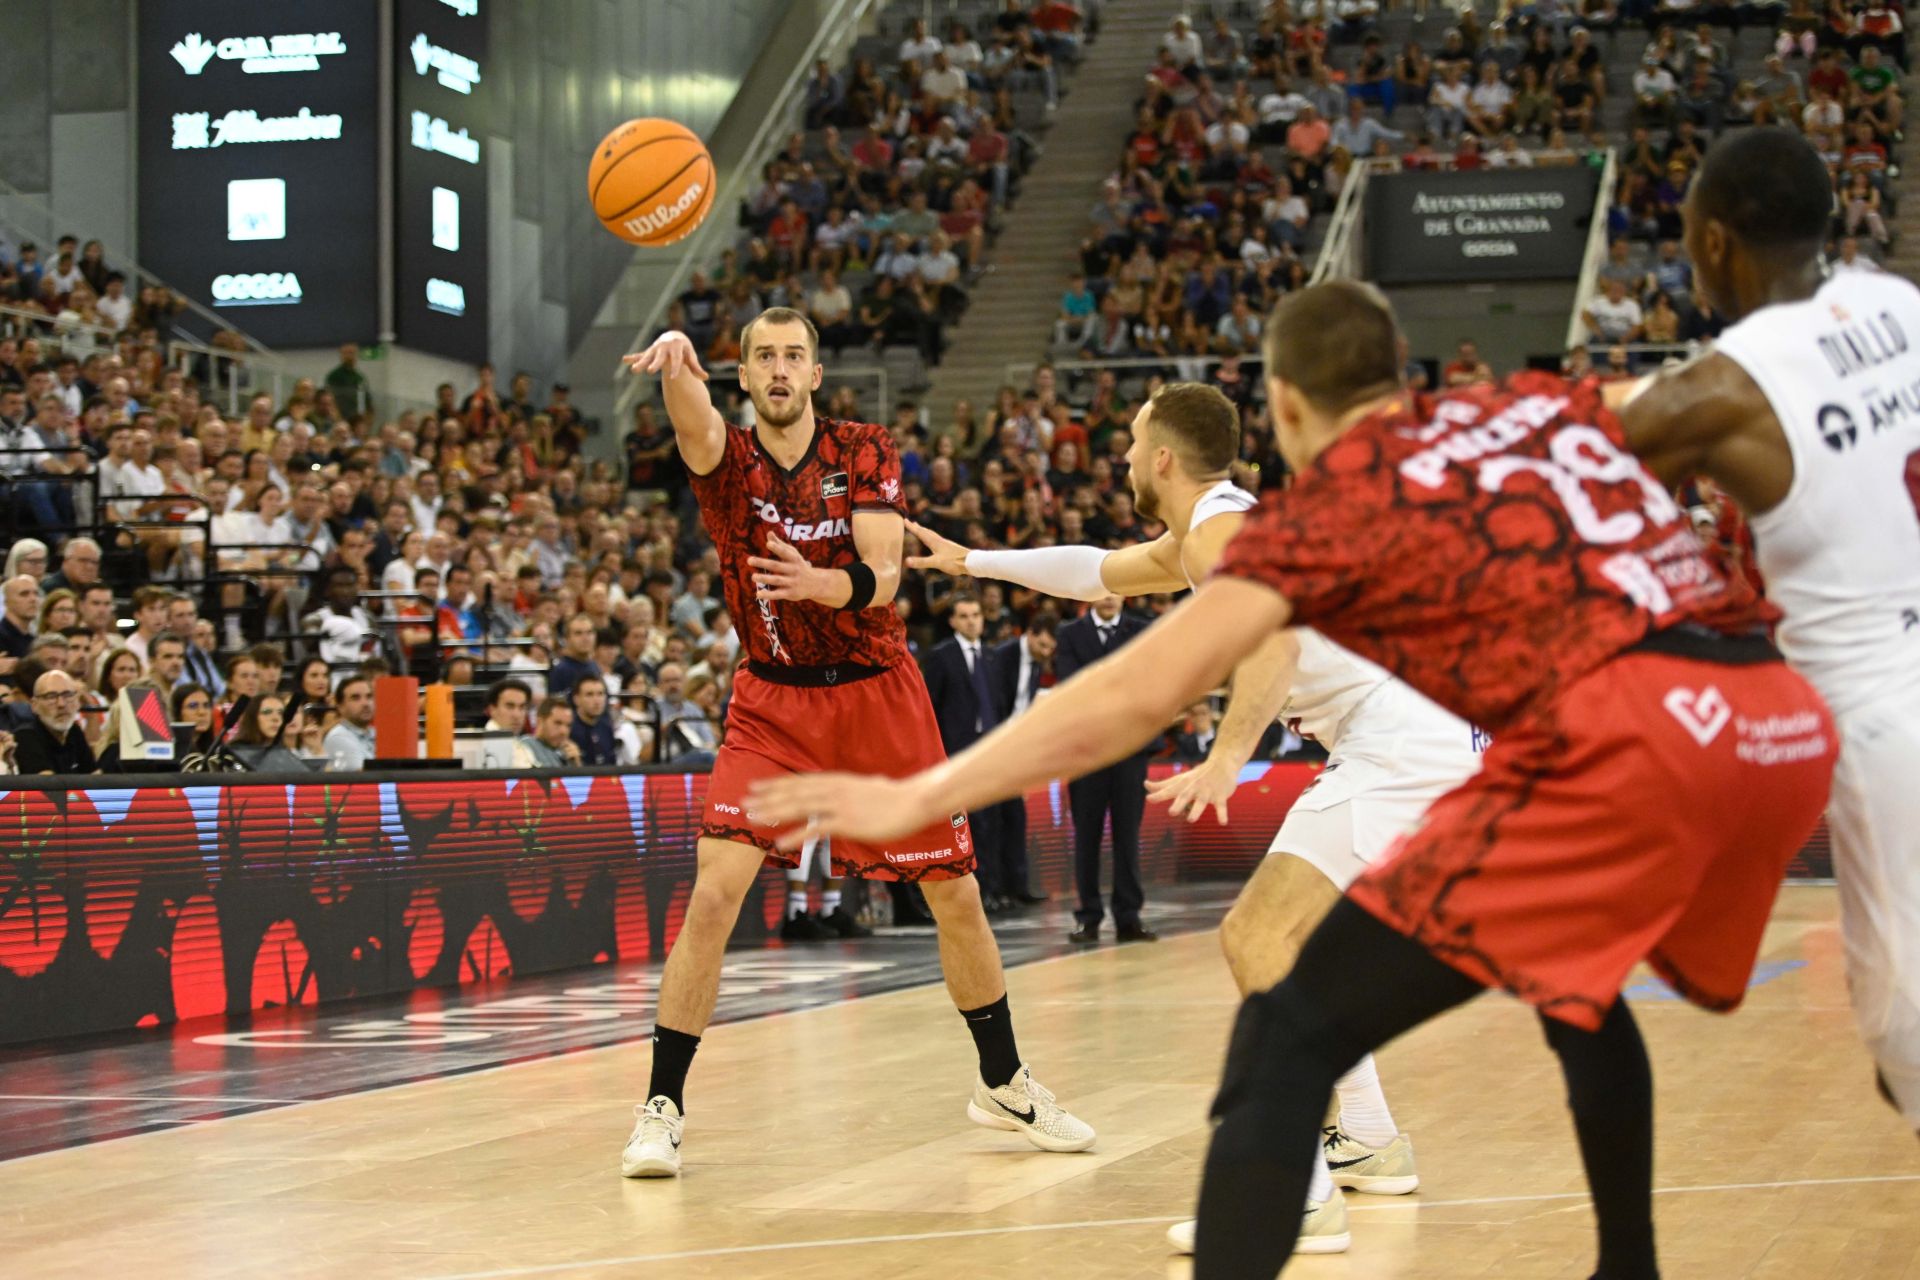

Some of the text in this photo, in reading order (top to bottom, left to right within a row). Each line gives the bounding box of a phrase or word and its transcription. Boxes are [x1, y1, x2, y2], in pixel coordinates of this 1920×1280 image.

[624, 182, 702, 237] Wilson
[1818, 312, 1909, 378] DIALLO
[714, 802, 740, 815] vive
[954, 815, 965, 826] acb
[896, 848, 953, 863] BERNER
